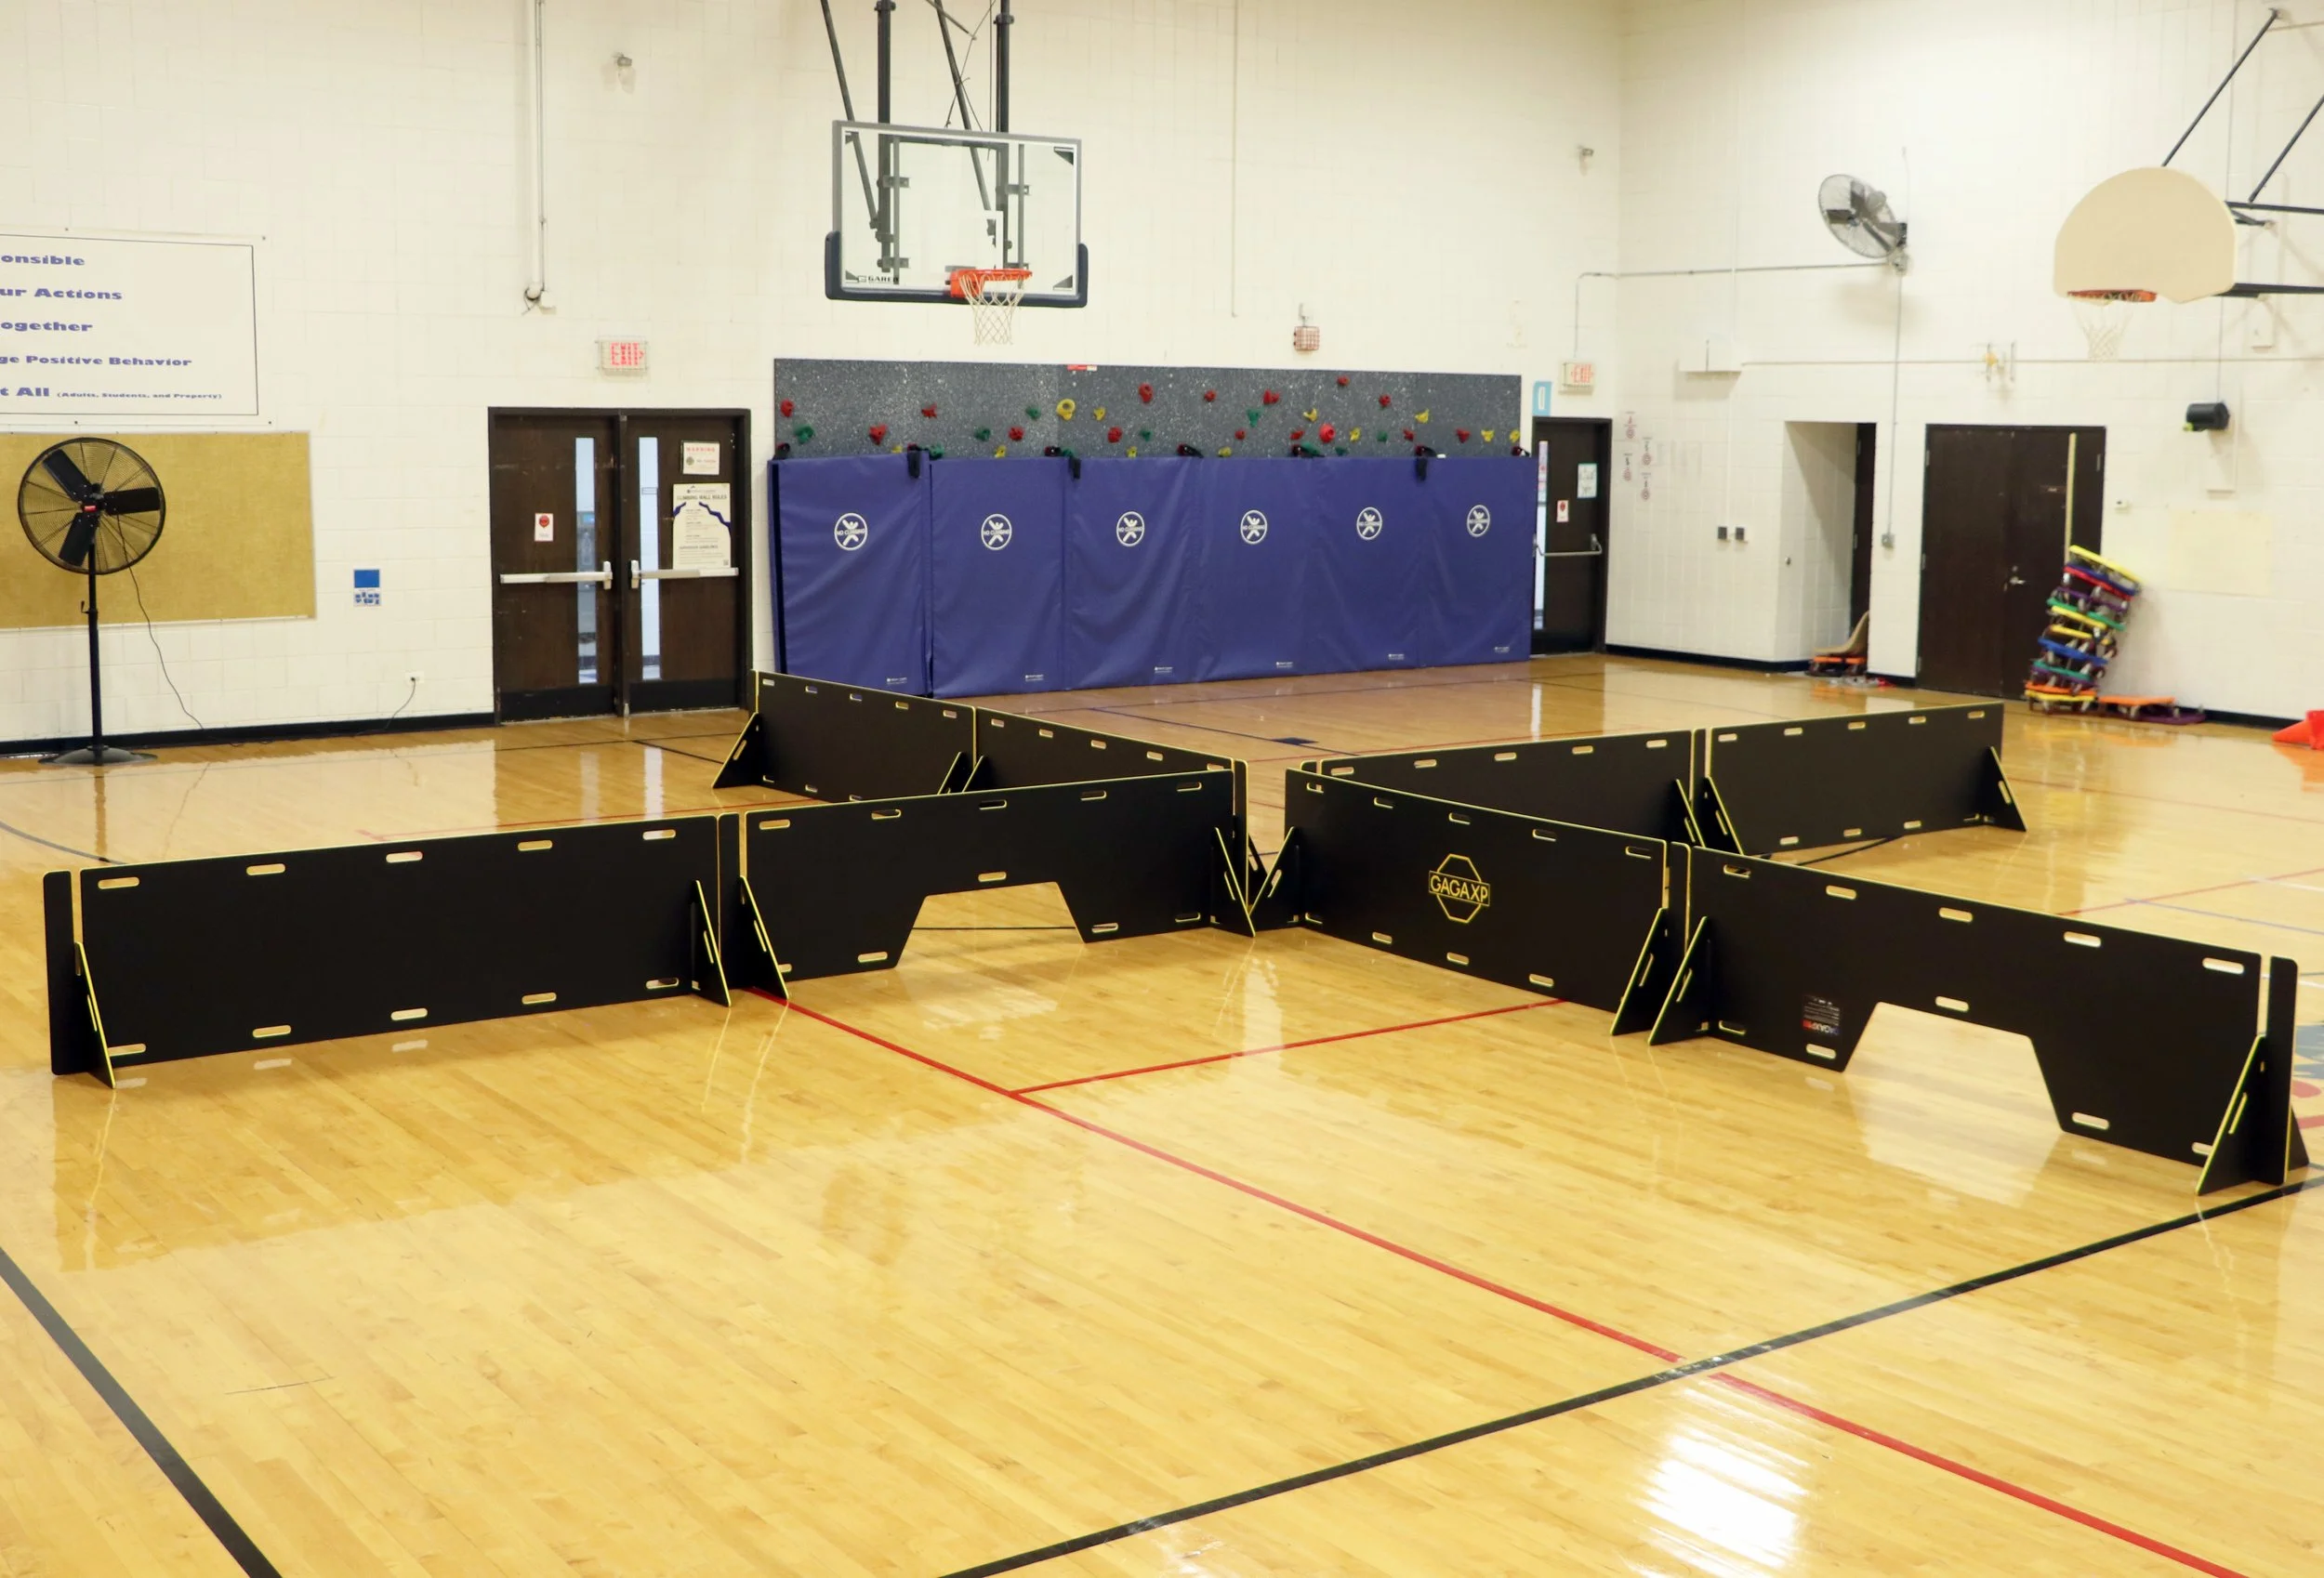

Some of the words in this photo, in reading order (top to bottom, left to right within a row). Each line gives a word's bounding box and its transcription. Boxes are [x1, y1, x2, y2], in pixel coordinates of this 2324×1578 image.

[34, 287, 123, 300] Actions
[0, 321, 93, 332] ogether
[610, 342, 639, 366] EXIT
[25, 355, 103, 365] Positive
[109, 357, 192, 366] Behavior
[16, 387, 50, 397] All
